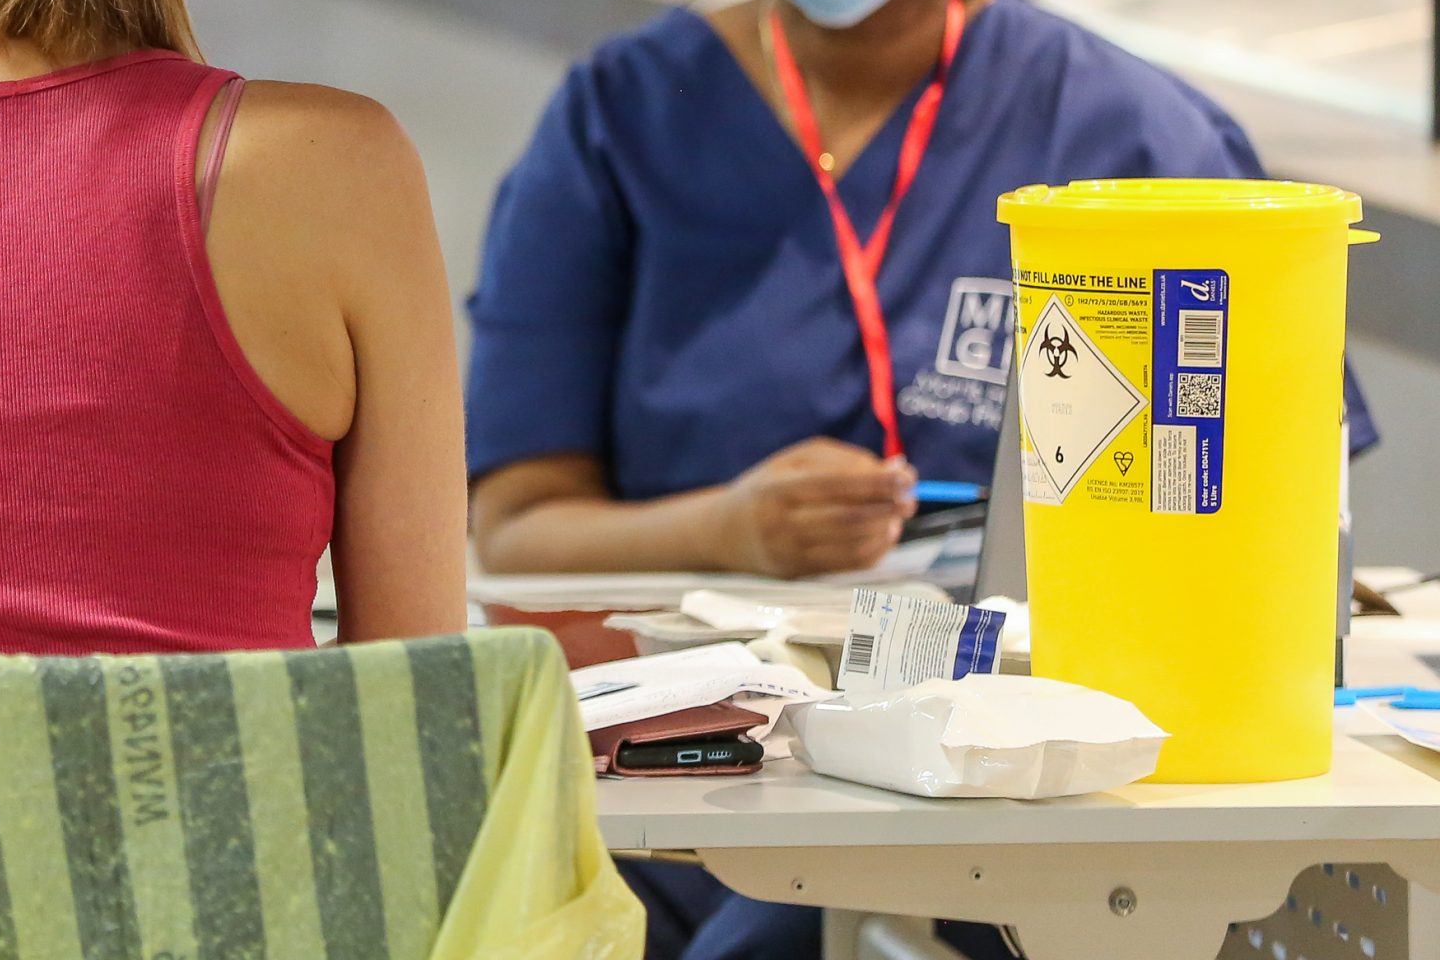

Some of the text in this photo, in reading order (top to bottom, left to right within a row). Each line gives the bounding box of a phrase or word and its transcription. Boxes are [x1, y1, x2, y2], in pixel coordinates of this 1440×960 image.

[1020, 269, 1031, 282] NOT
[1033, 271, 1050, 284] FILL
[1052, 273, 1086, 286] ABOVE
[1089, 275, 1113, 288] THE
[1117, 277, 1147, 289] LINE
[1056, 446, 1064, 463] 6
